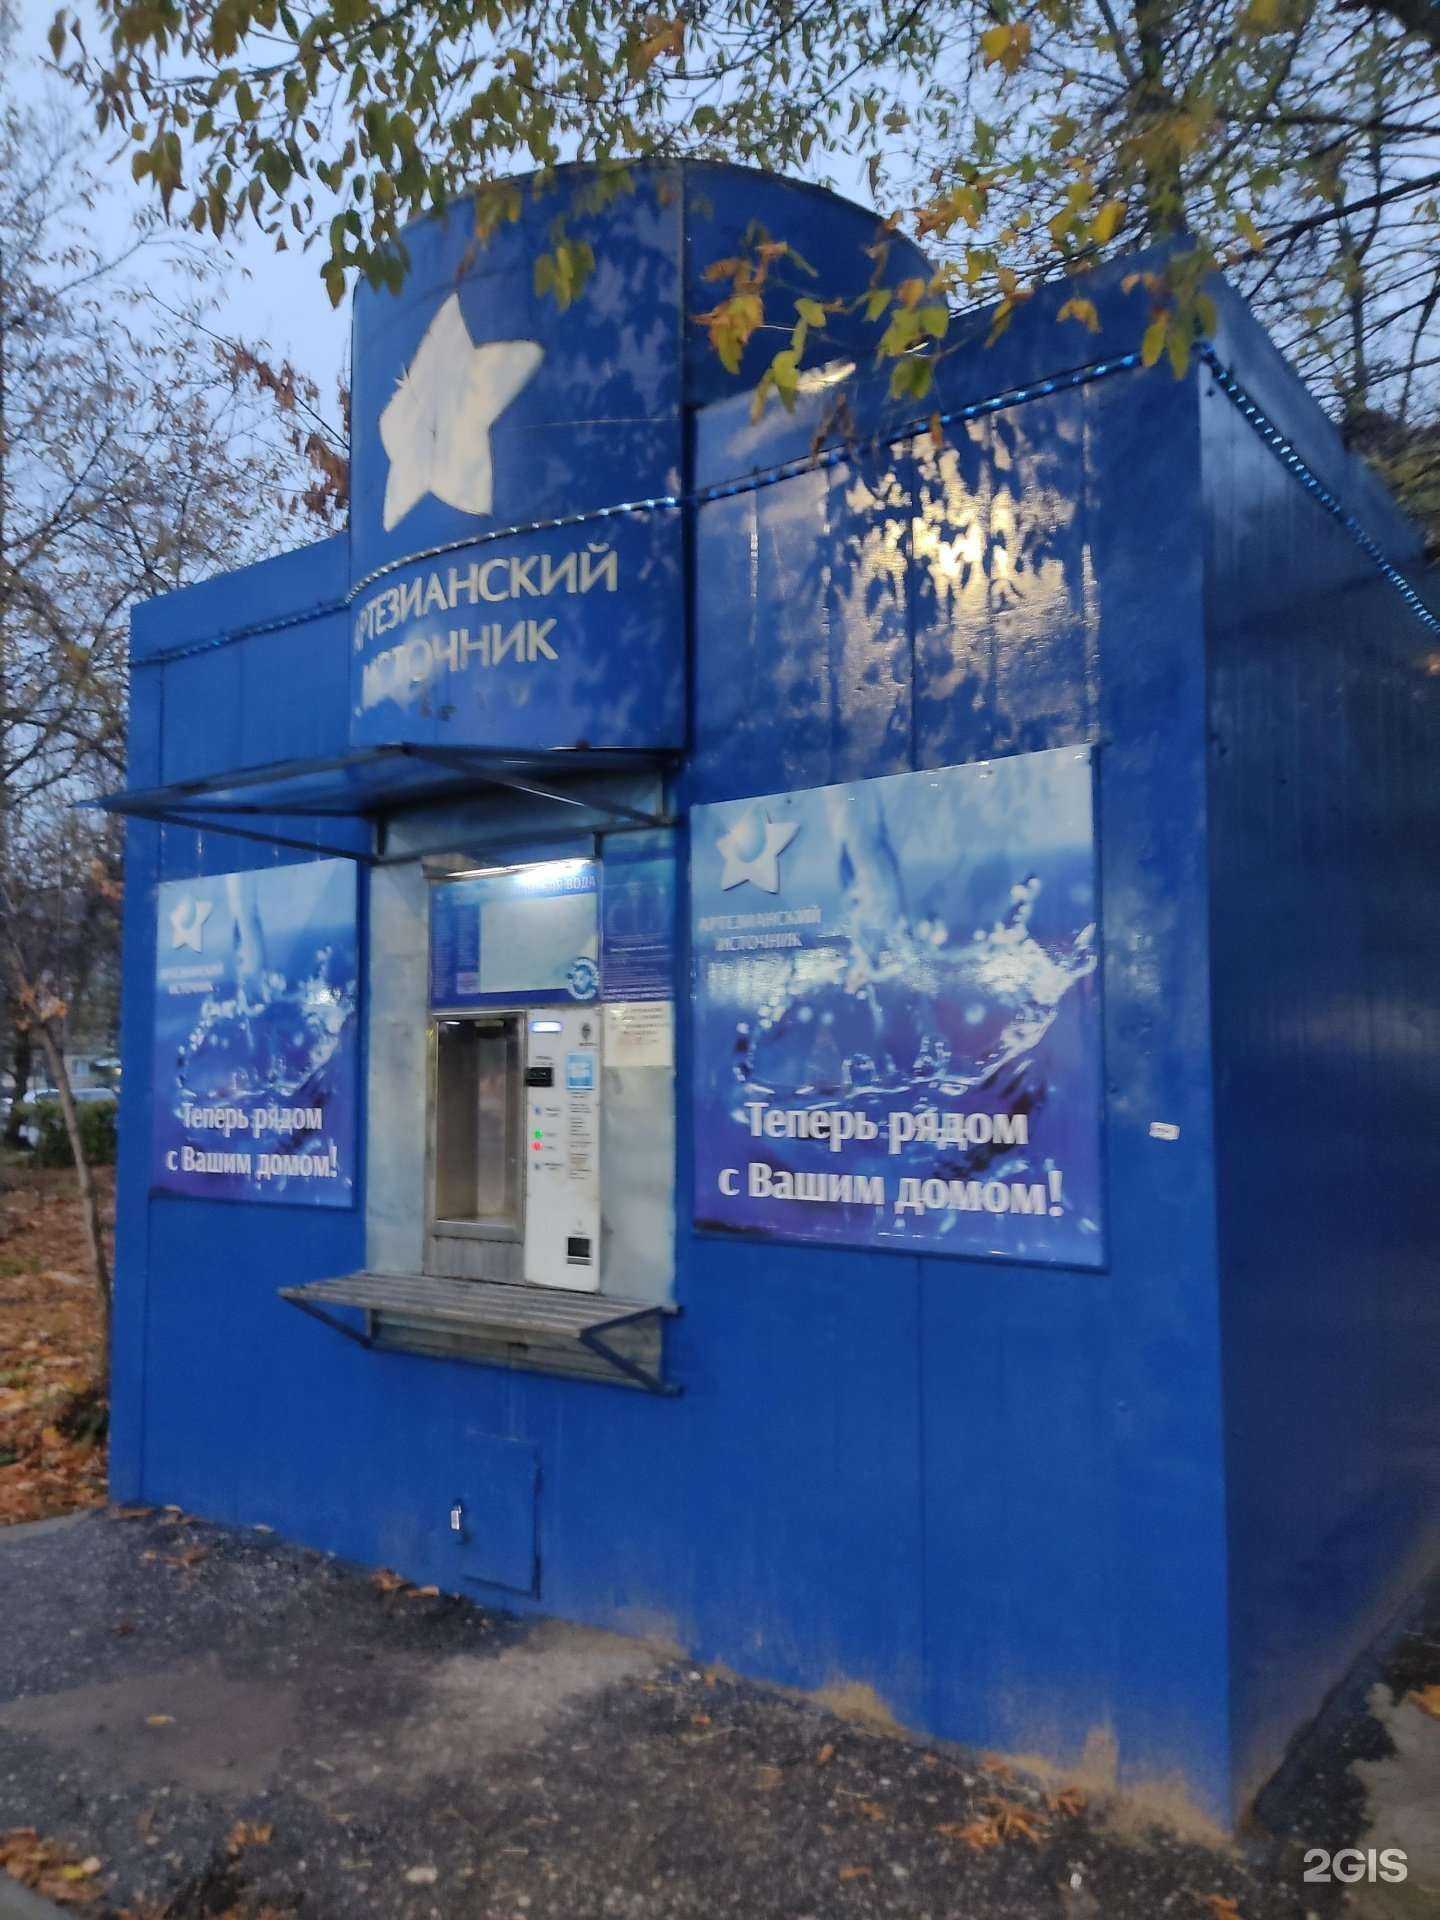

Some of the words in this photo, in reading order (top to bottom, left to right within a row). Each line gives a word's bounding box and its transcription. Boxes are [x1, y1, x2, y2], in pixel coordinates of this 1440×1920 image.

[354, 543, 618, 653] РТЕЗИАНСКИЙ
[181, 1102, 249, 1138] Теперь
[251, 1107, 322, 1139] рядом
[744, 1102, 879, 1152] Теперь
[888, 1111, 1029, 1155] рядом
[166, 1151, 178, 1171] с
[181, 1146, 251, 1174] Вашим
[256, 1146, 338, 1181] домом!
[718, 1168, 740, 1196] с
[748, 1162, 885, 1205] Вашим
[894, 1170, 1064, 1217] домом!
